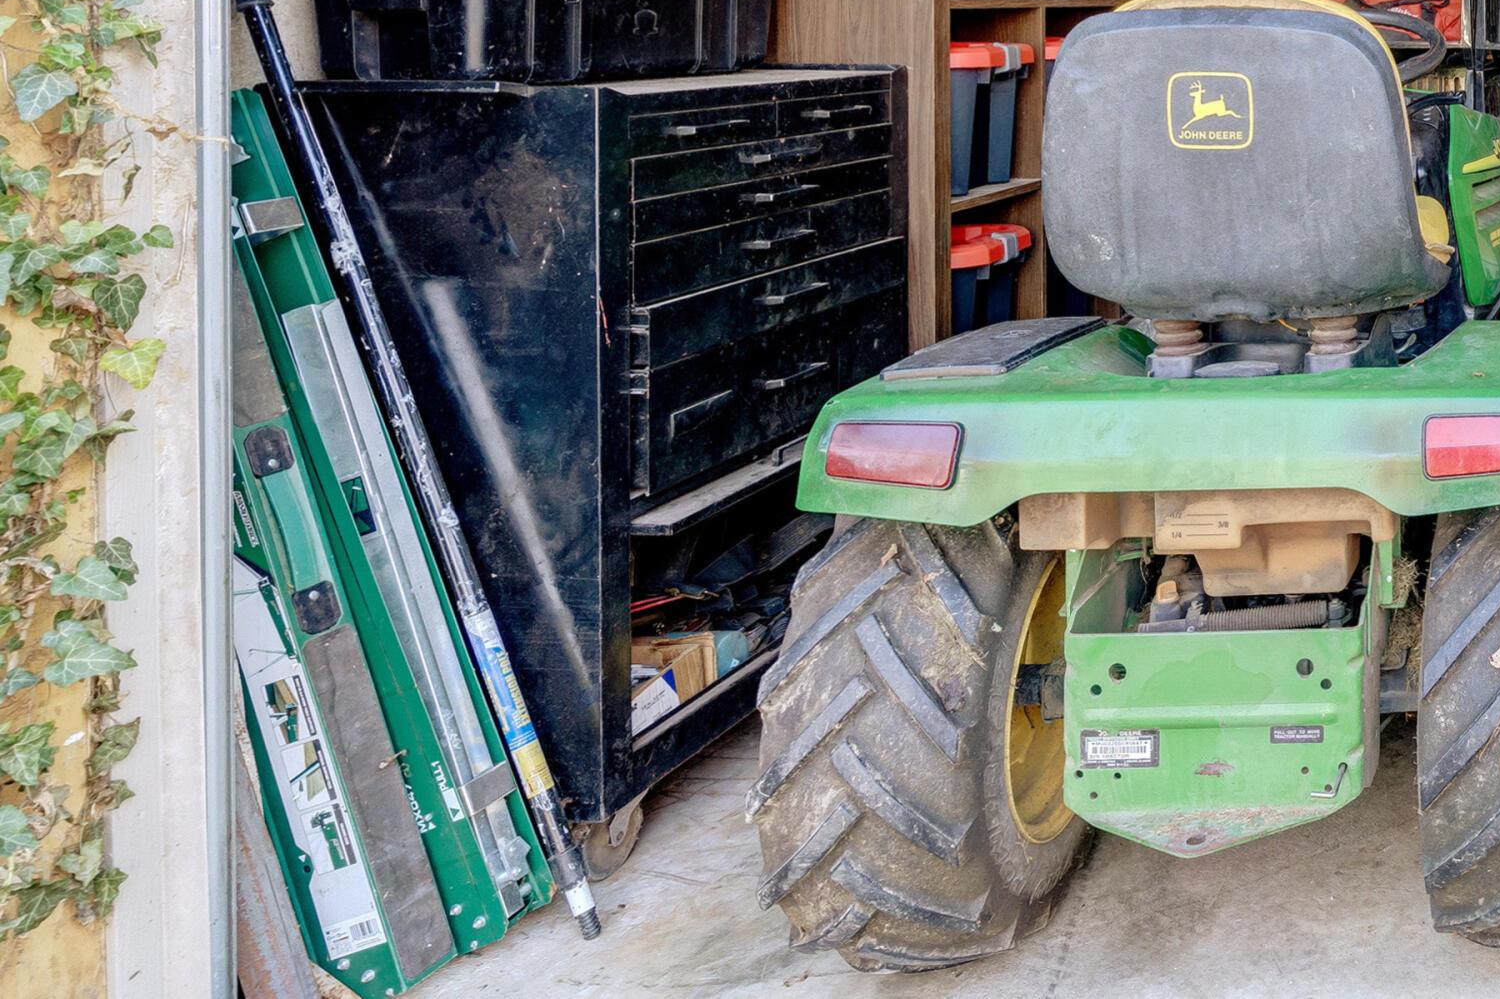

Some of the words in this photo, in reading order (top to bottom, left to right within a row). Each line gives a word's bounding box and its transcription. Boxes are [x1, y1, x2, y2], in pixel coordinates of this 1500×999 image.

[1178, 130, 1207, 140] JOHN
[1208, 130, 1243, 140] DEERE
[1171, 531, 1183, 539] 1/4
